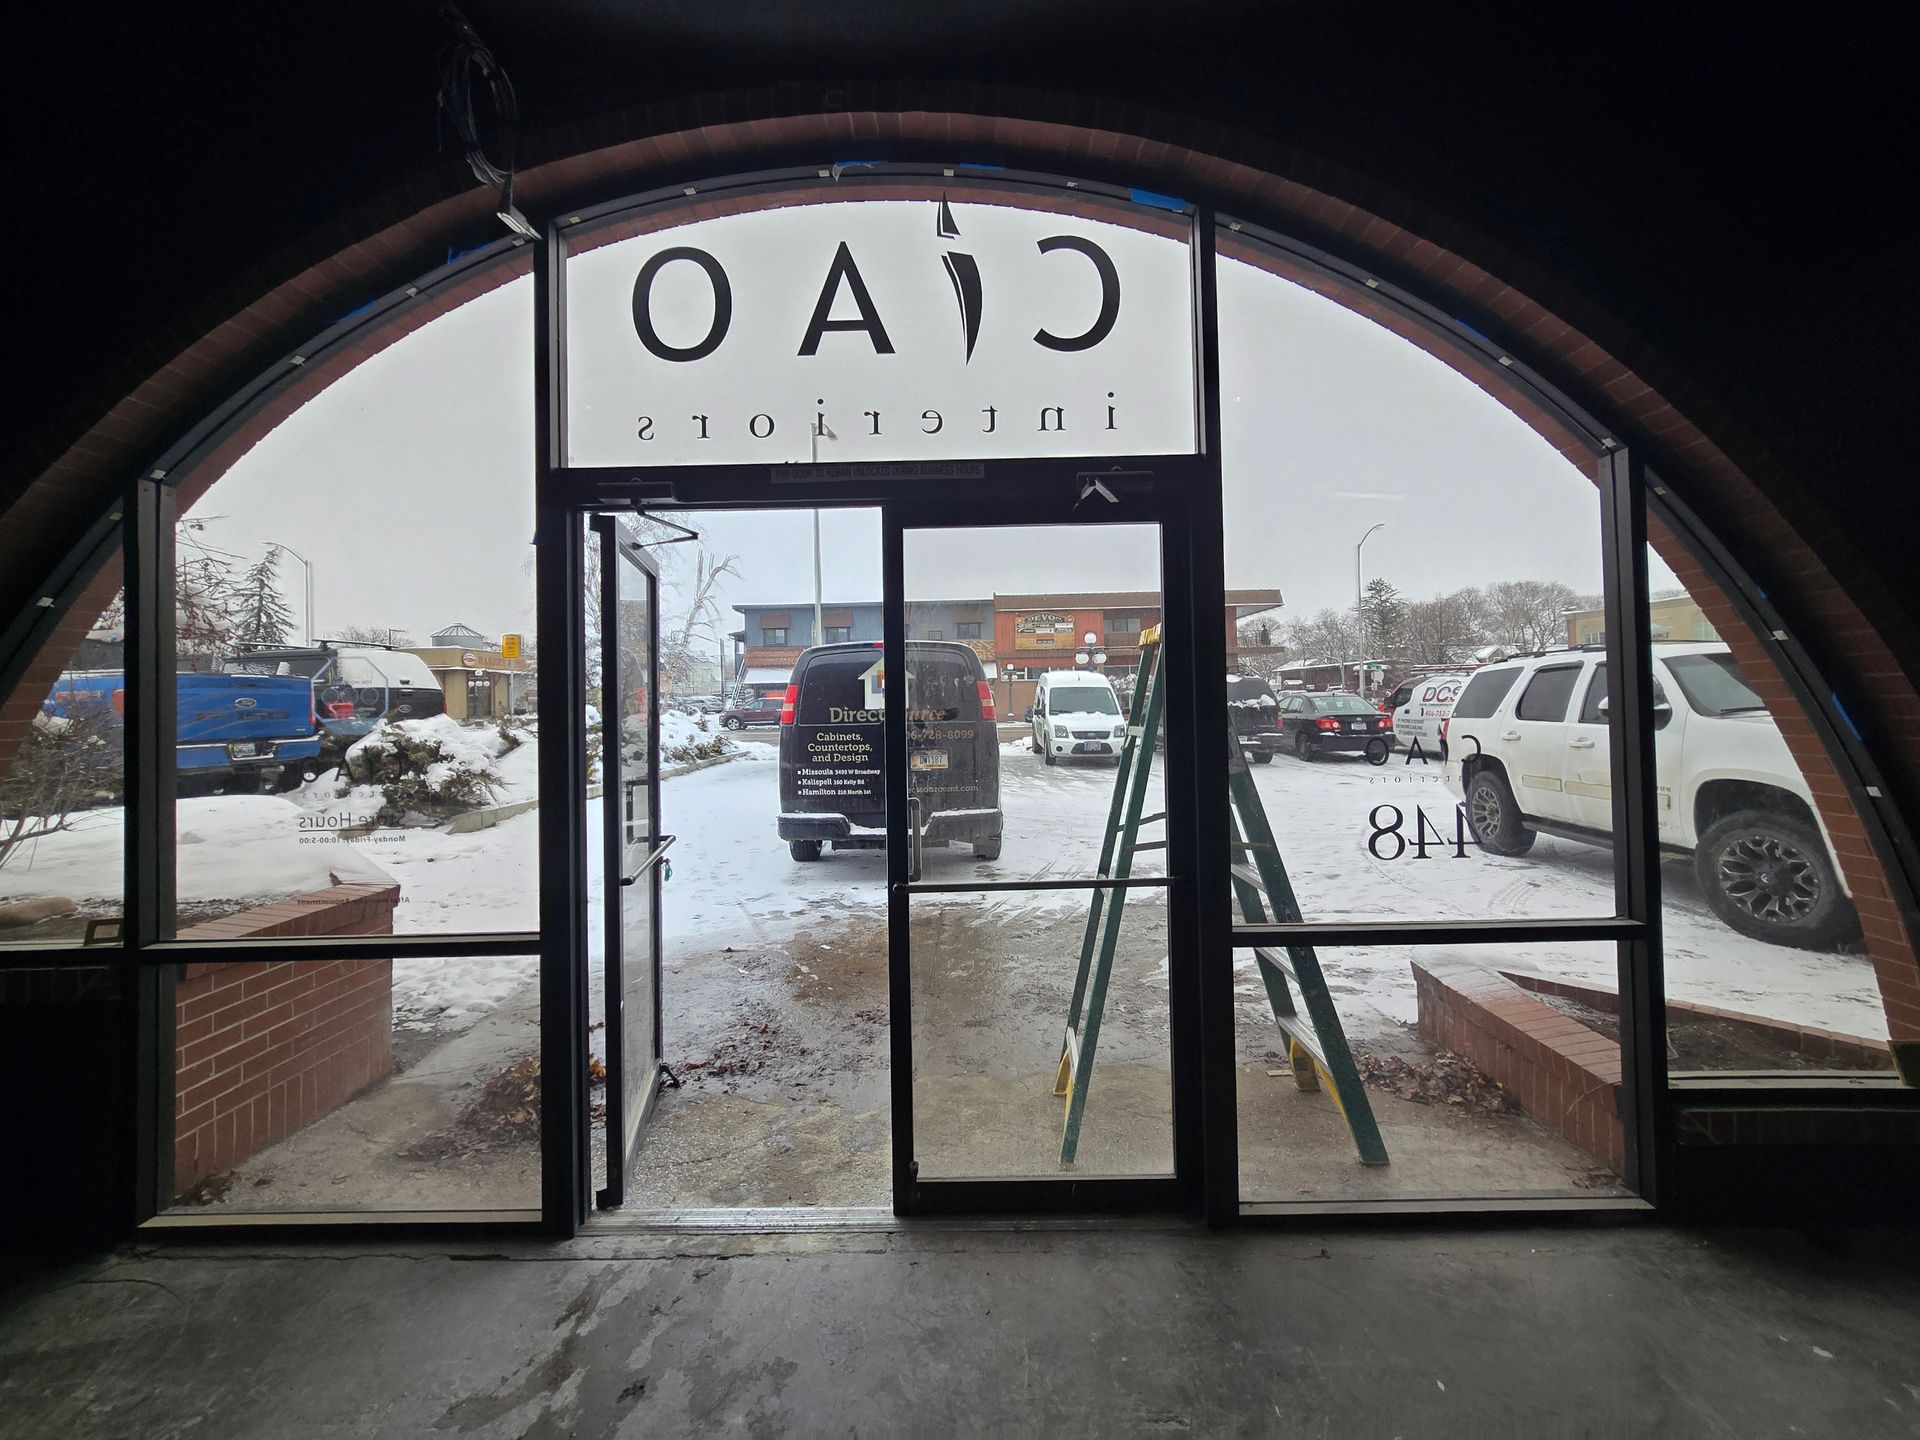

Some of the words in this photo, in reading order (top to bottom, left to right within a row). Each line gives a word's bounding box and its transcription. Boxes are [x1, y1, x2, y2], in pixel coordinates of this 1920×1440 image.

[793, 468, 813, 479] DOOR
[815, 467, 825, 478] TO
[826, 467, 852, 477] REMAIN
[853, 466, 890, 477] UNLOCKED
[920, 464, 954, 475] BUSINESS
[956, 463, 981, 474] HOURS
[829, 707, 885, 722] Direct
[816, 732, 863, 741] Cabinets,
[907, 730, 974, 740] 06-728-8099
[807, 743, 873, 752] Countertops,
[812, 754, 831, 762] and
[833, 753, 869, 763] Design
